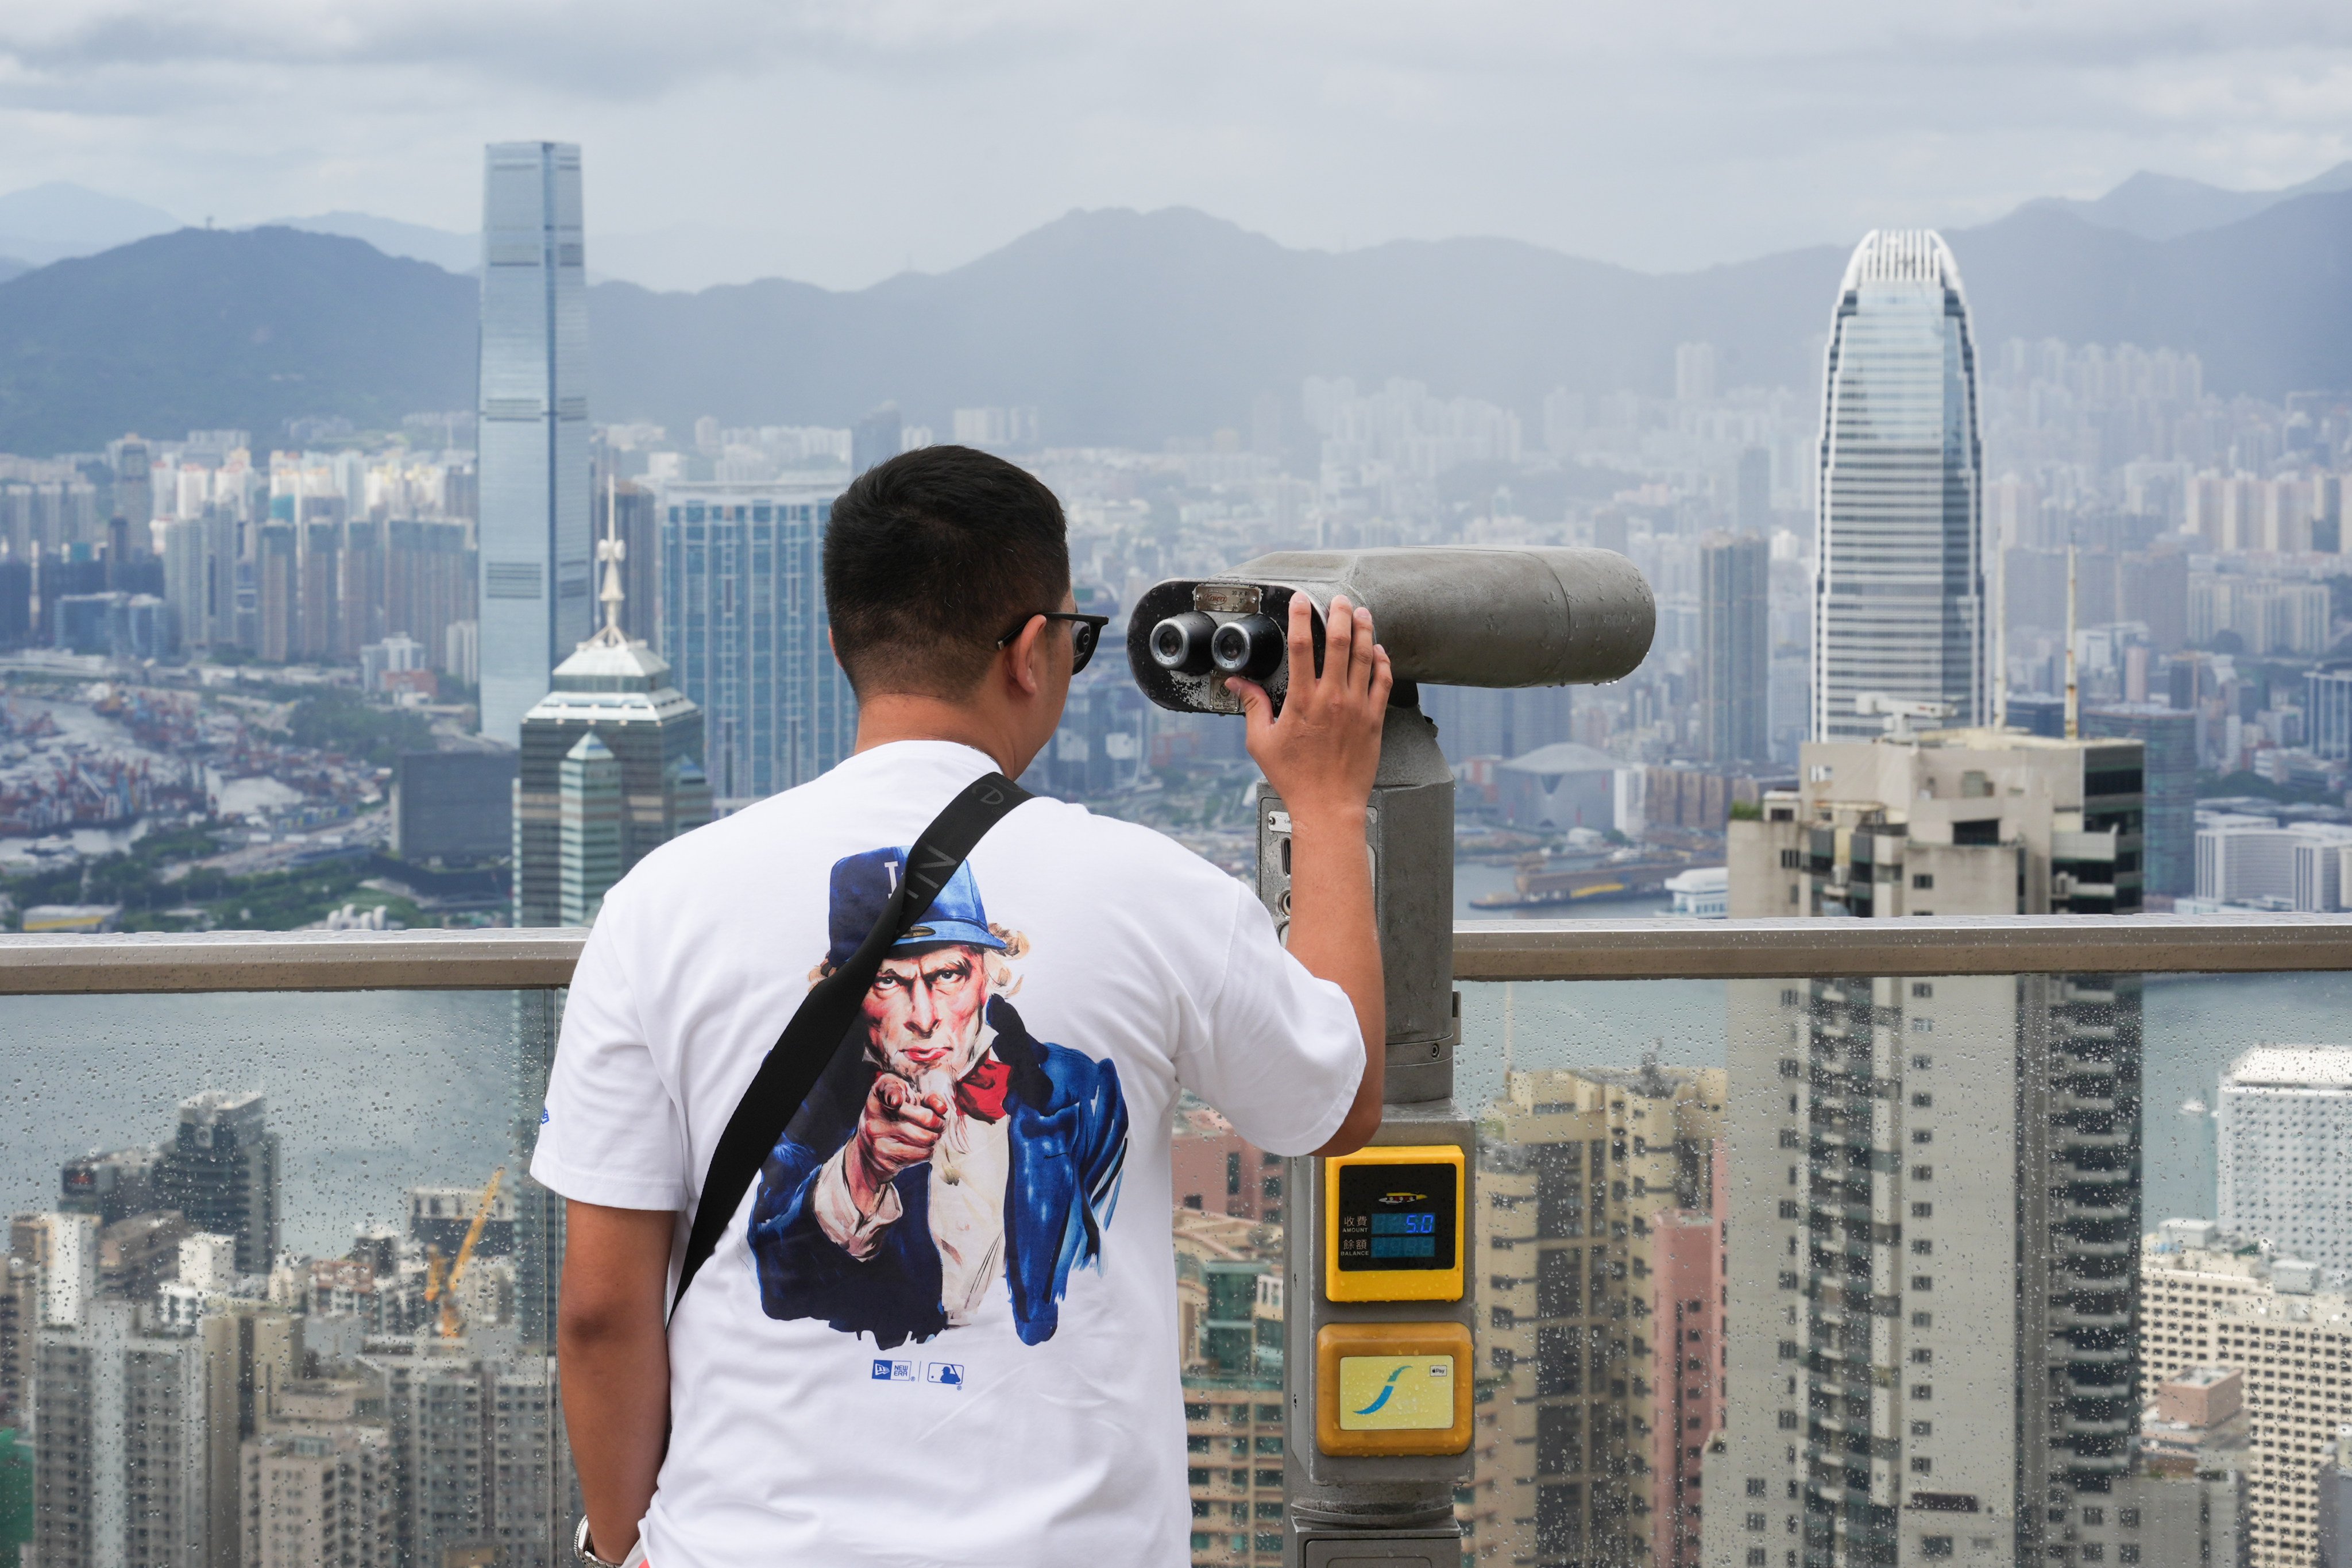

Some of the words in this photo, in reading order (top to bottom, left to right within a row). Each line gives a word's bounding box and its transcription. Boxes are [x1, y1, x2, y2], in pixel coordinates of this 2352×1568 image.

[1344, 1216, 1367, 1227] 收費
[1406, 1214, 1434, 1233] 5.0
[1343, 1239, 1367, 1250] 餘額
